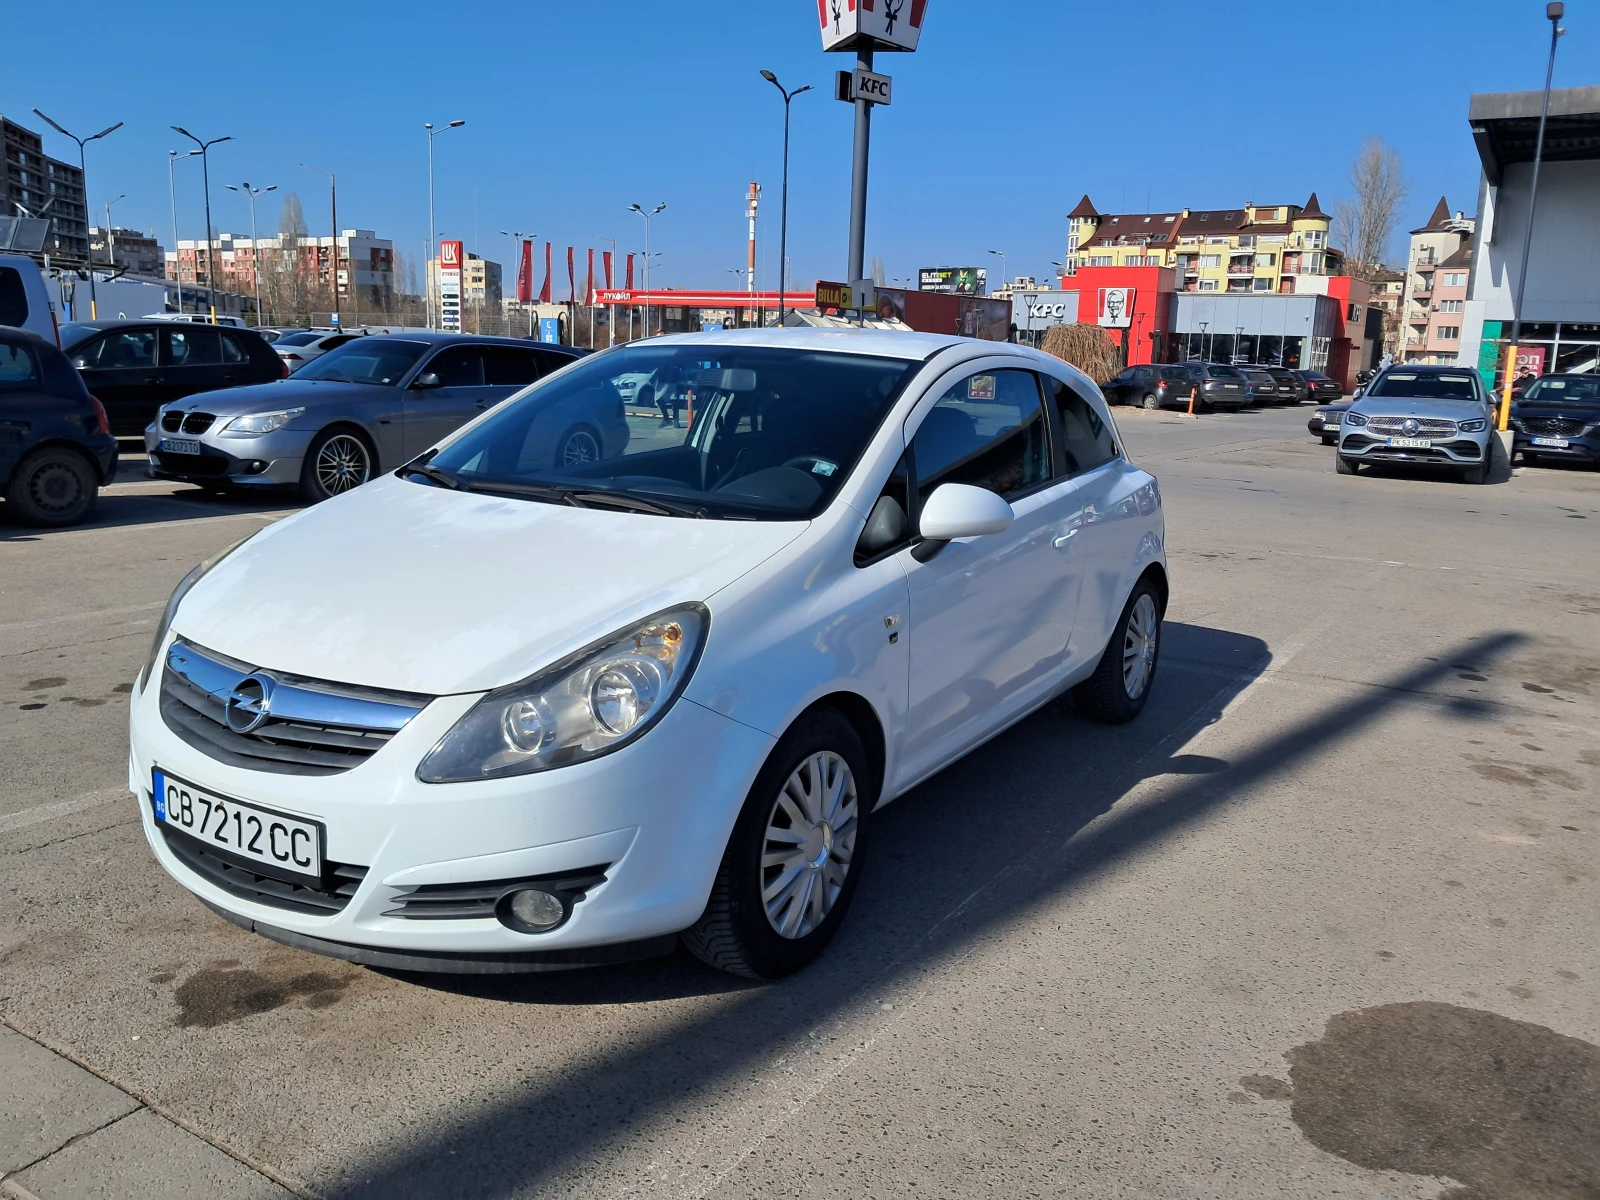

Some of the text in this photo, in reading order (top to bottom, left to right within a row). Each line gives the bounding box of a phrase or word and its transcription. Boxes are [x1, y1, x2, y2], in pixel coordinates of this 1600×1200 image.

[859, 76, 889, 97] KFC
[603, 291, 631, 301] ЛУКОЙЛ
[817, 288, 840, 304] BILLA
[1030, 303, 1066, 318] KFC
[156, 800, 165, 814] BG
